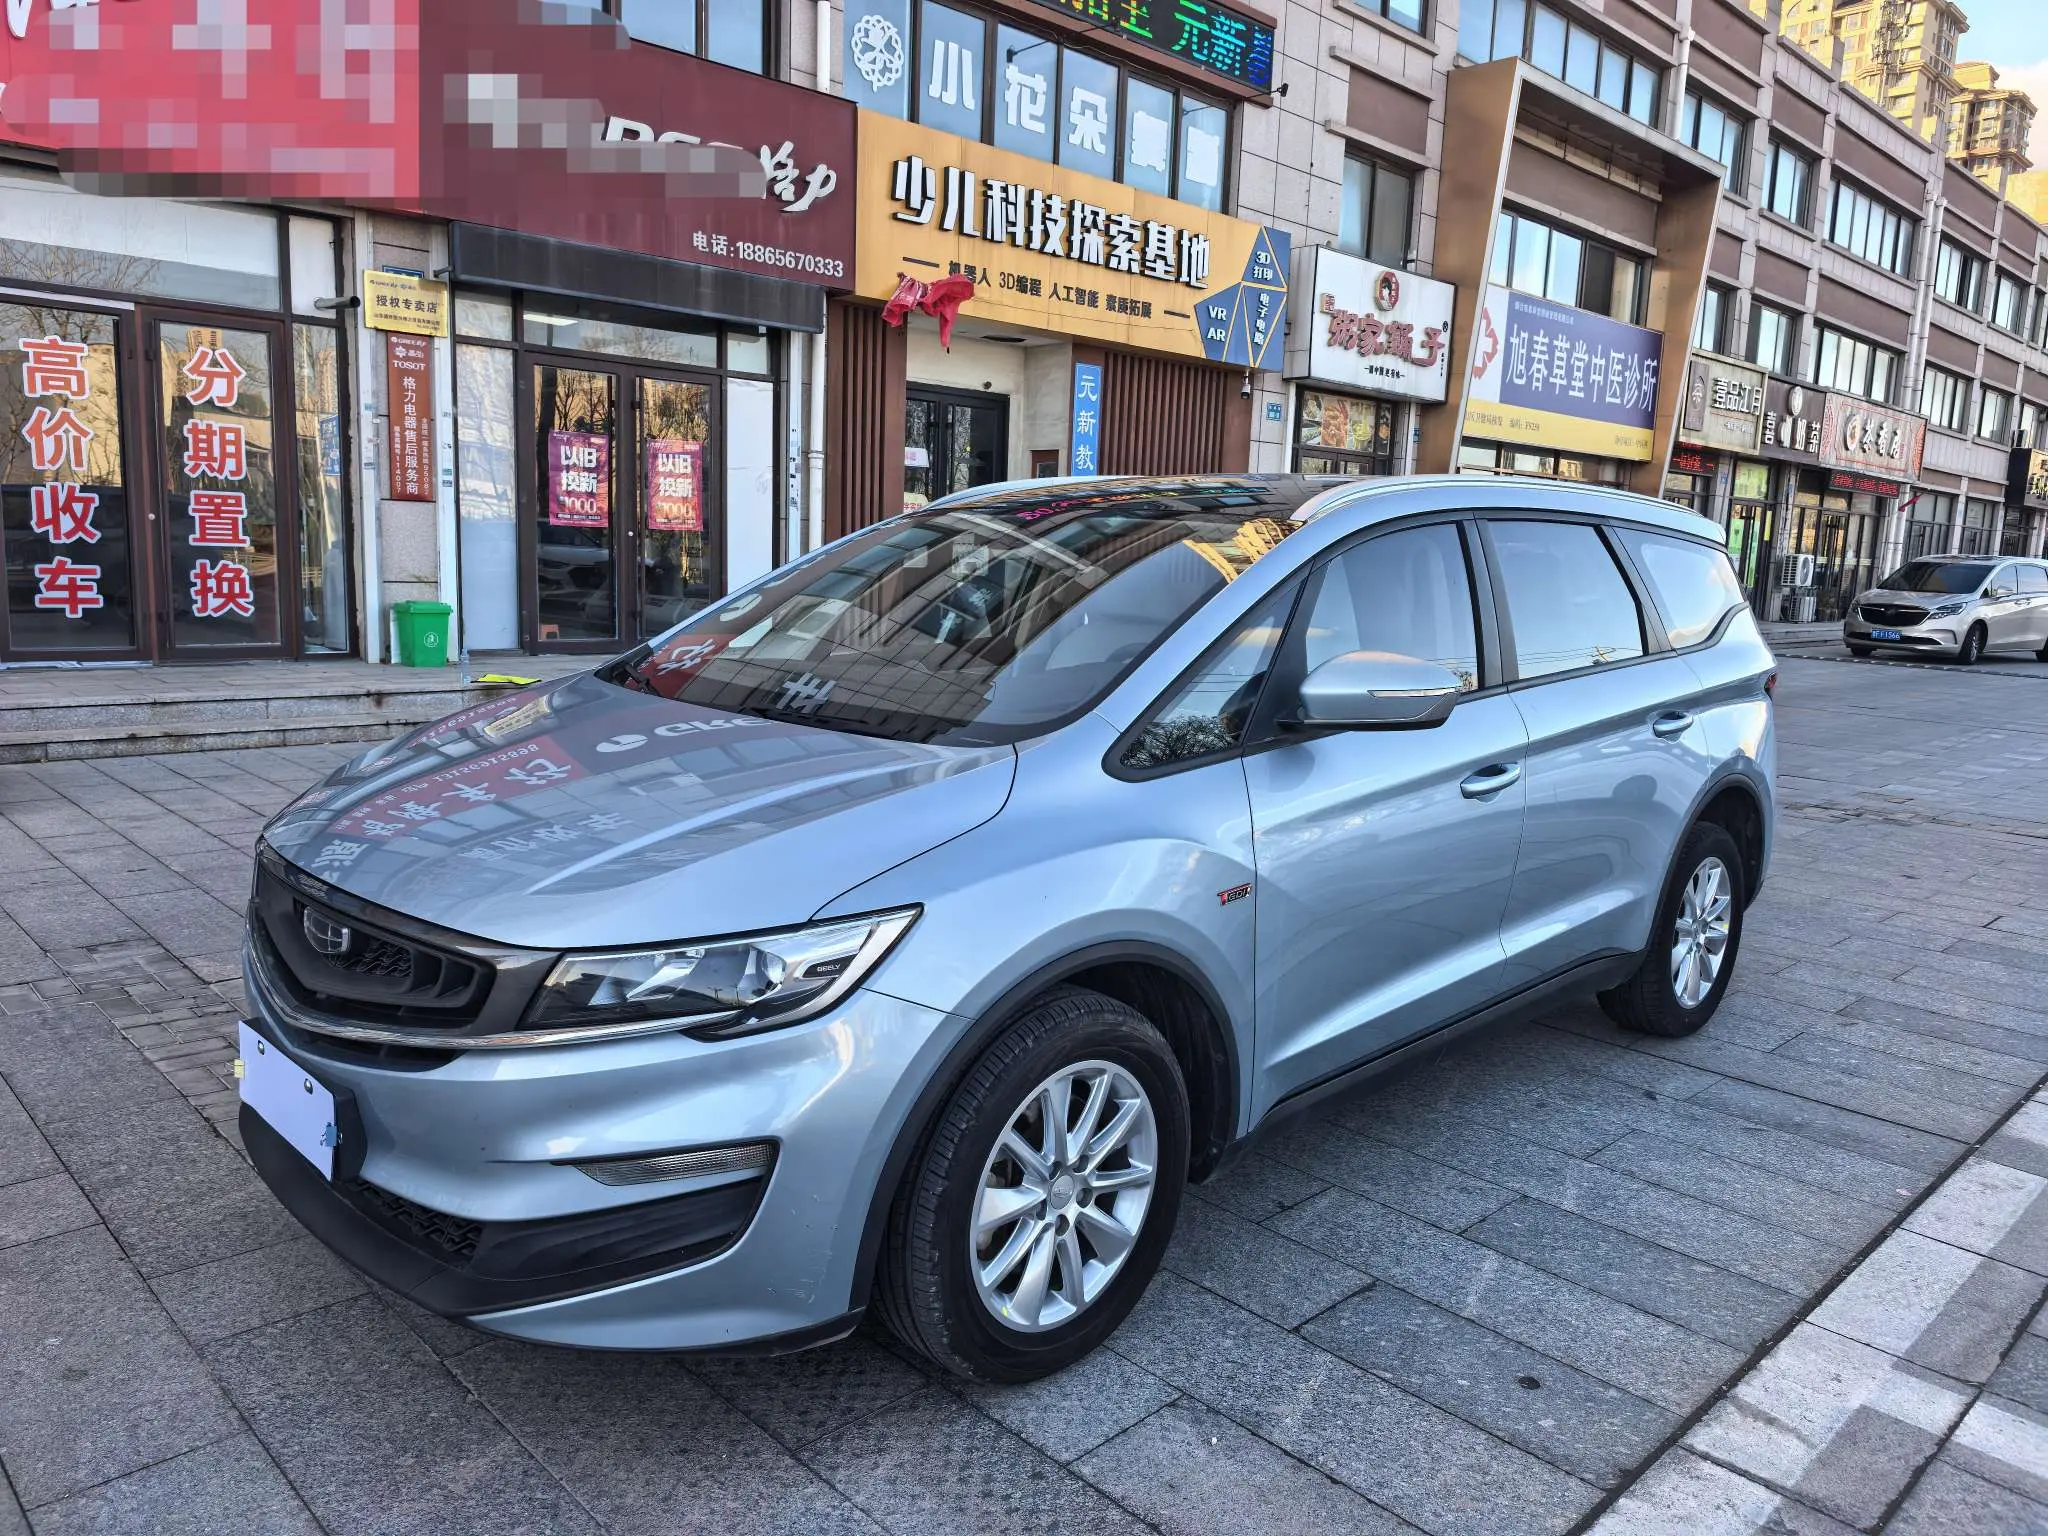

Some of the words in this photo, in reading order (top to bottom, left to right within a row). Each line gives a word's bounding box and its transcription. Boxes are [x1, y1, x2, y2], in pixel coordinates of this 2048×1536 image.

[893, 155, 1210, 290] 少儿科技探索基地
[692, 231, 844, 277] 电话:18865670333
[1255, 251, 1271, 265] 3D
[1253, 265, 1273, 281] 打印
[376, 294, 438, 314] 授权专卖店
[999, 272, 1042, 298] 3D编程
[1048, 283, 1099, 309] 人工智能
[1105, 293, 1153, 319] 素质拓展
[1207, 304, 1227, 321] VR
[1253, 293, 1270, 346] 电子电路
[1207, 327, 1226, 342] AR
[392, 360, 426, 370] TOSOT
[1506, 322, 1658, 413] 旭春草堂中医诊所
[1074, 374, 1098, 472] 元新教
[402, 376, 418, 495] 格力电器售后服务商
[560, 445, 598, 468] 以旧
[657, 453, 692, 474] 以旧
[19, 335, 104, 619] 高价收车
[183, 347, 254, 619] 分期置换
[561, 471, 598, 493] 换新
[659, 476, 692, 497] 换新
